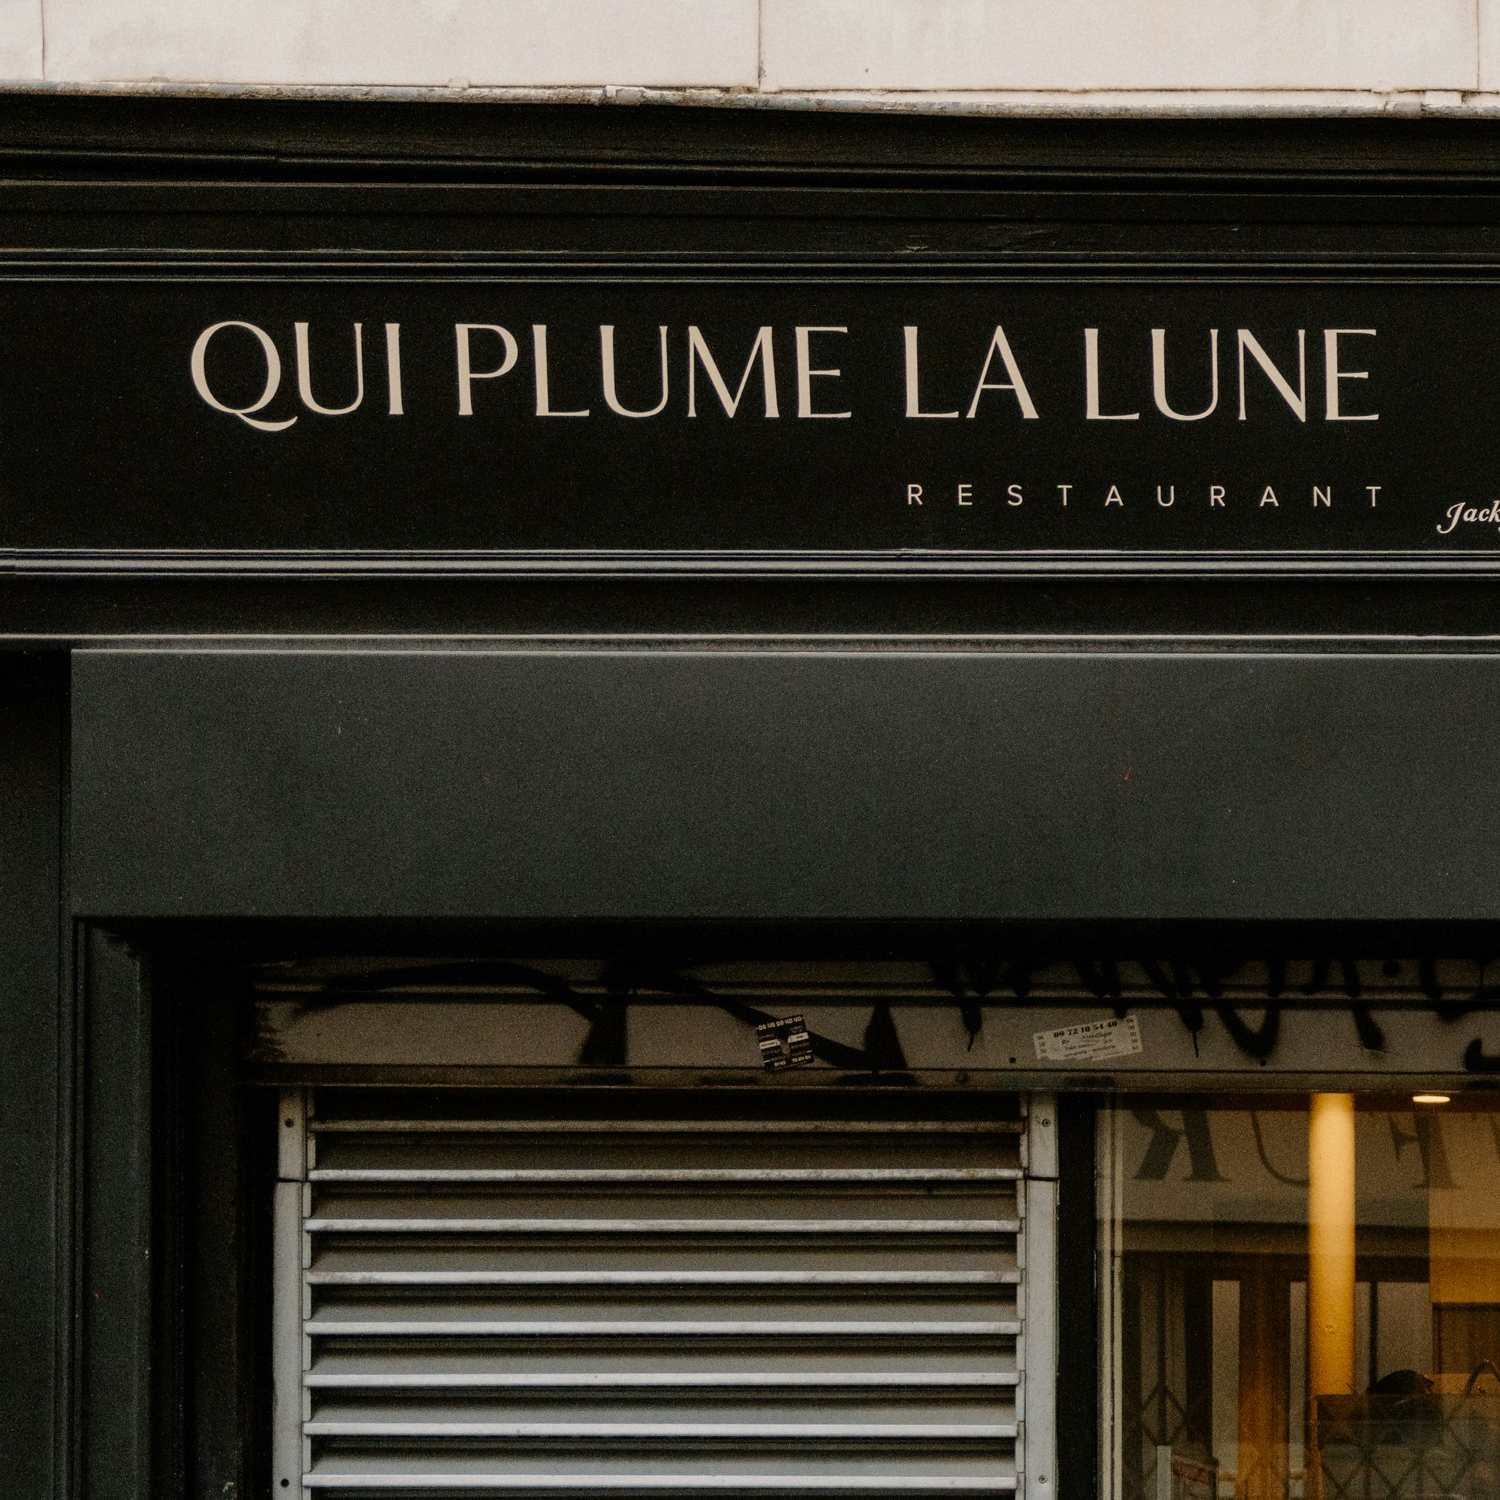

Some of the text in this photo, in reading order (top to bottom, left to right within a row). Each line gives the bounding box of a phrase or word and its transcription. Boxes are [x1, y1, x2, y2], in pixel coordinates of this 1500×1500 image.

[190, 321, 1381, 433] QUI PLUME LA LUNE
[908, 483, 1384, 509] RESTAURANT
[1067, 1028, 1078, 1036] 72
